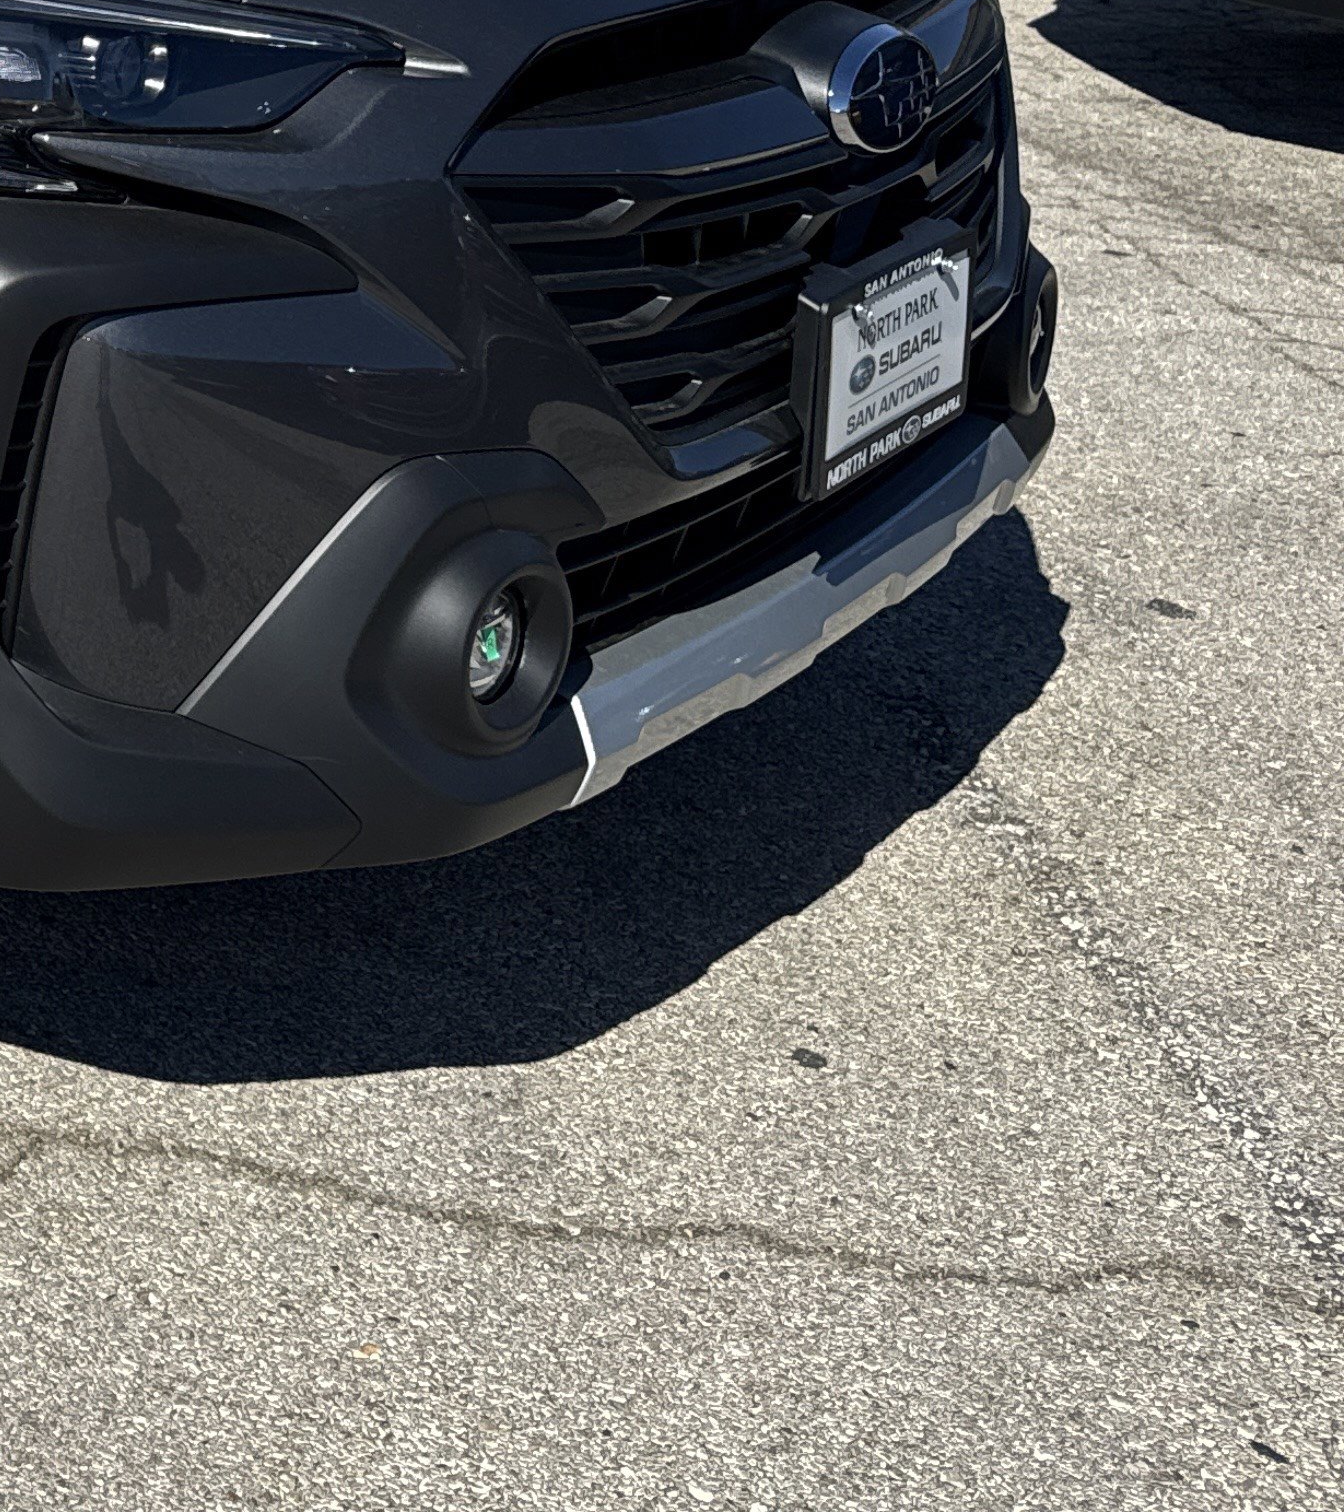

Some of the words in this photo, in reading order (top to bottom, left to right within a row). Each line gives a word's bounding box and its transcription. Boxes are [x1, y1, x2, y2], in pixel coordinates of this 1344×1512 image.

[864, 274, 888, 298] SAN
[890, 247, 944, 285] ANTONIO
[857, 307, 903, 353] NORTH
[904, 287, 939, 327] PARK
[878, 320, 943, 376] SUBARU
[846, 401, 877, 436] SAN
[877, 365, 940, 417] ANTONIO
[826, 447, 868, 490] NORTH
[869, 426, 903, 464] PARK
[921, 393, 962, 429] SUBARU
